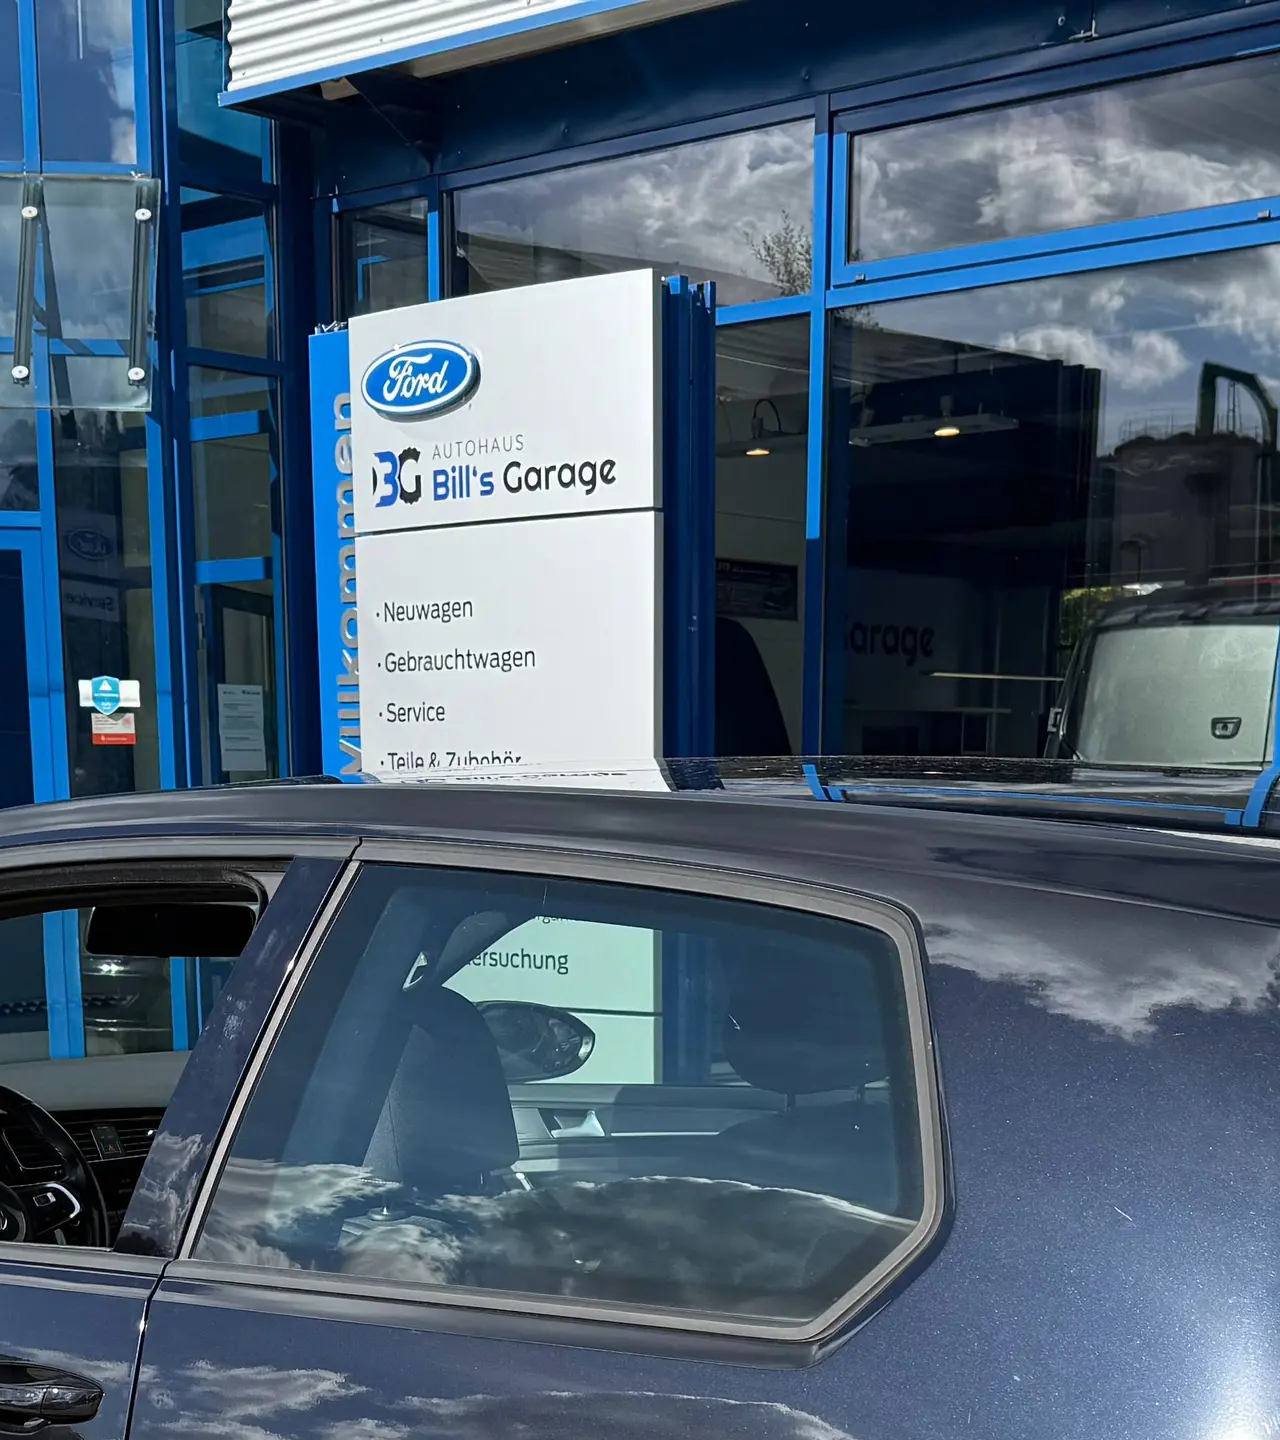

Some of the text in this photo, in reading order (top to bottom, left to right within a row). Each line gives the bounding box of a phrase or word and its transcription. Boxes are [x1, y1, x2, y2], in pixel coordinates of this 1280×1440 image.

[382, 354, 447, 401] Ford
[432, 434, 524, 460] AUTOHAUS
[503, 458, 617, 496] Garage
[384, 600, 473, 623] Neuwagen
[844, 614, 935, 667] arage
[385, 648, 536, 673] Gebrauchtwagen
[386, 702, 445, 723] Service
[467, 948, 569, 975] ersuchung
